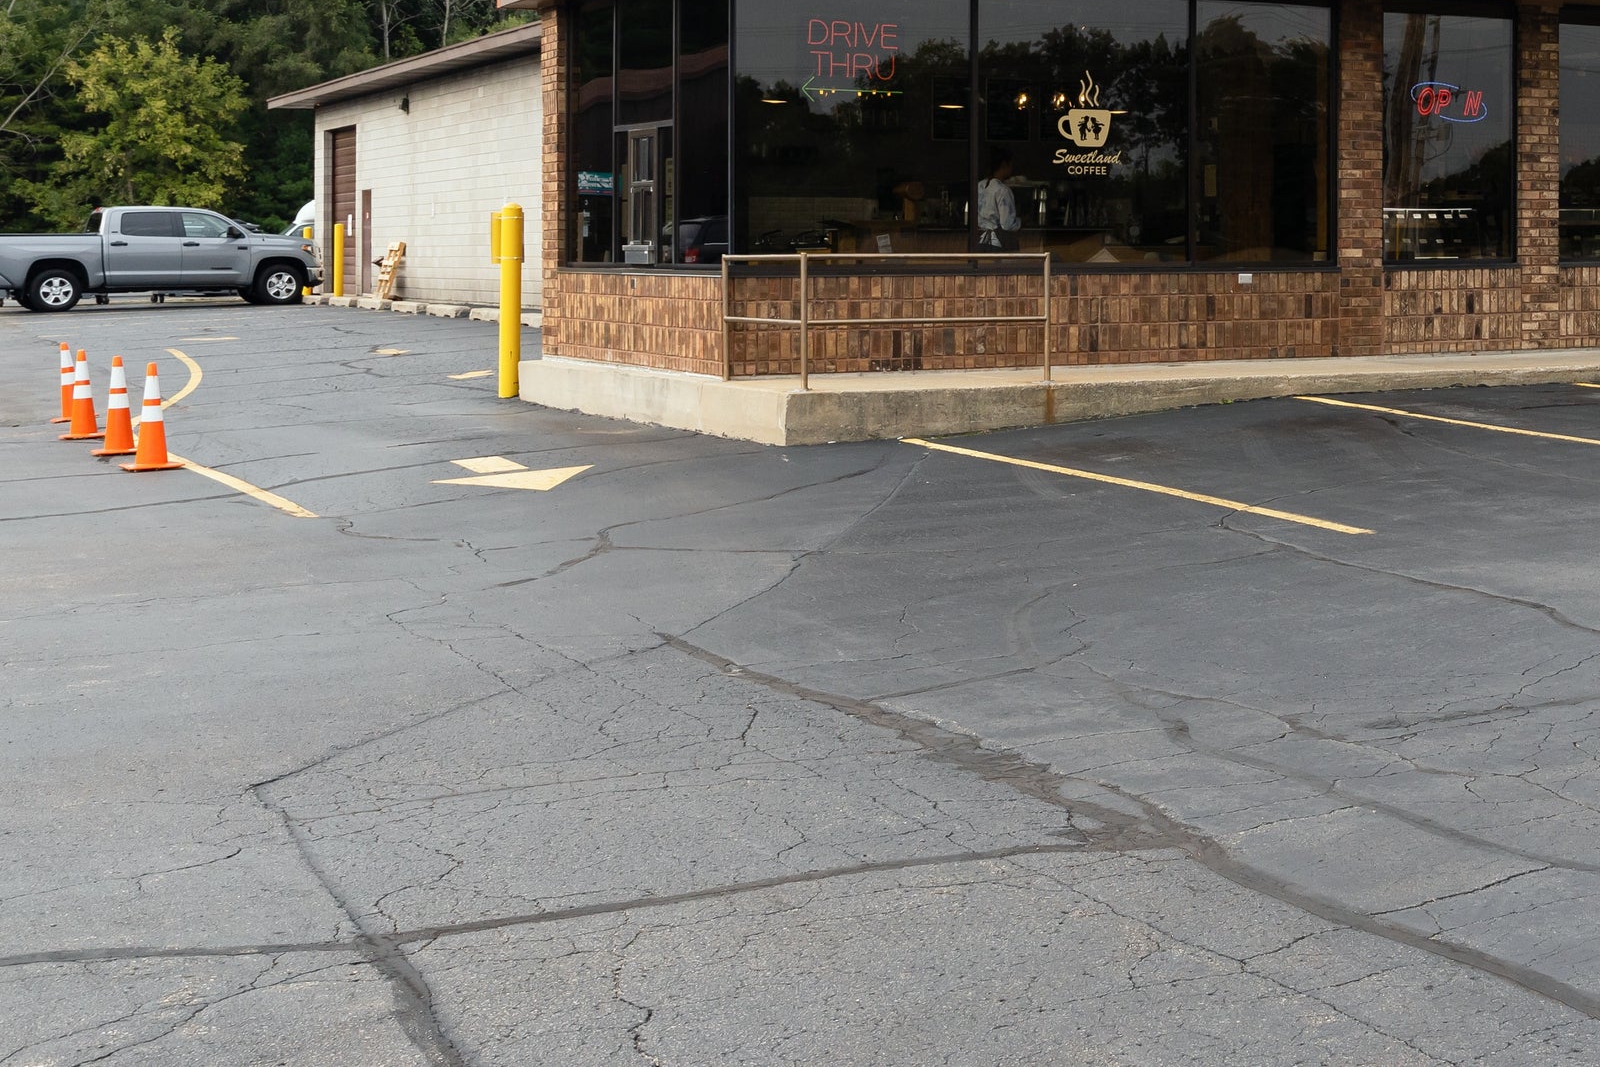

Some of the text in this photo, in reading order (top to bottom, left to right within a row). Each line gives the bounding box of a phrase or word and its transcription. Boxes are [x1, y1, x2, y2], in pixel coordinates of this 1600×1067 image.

[807, 19, 898, 50] DRIVE
[810, 51, 895, 81] THRU
[1417, 87, 1482, 116] OPN
[1053, 149, 1122, 164] Sweetland
[1067, 166, 1107, 175] COFFEE
